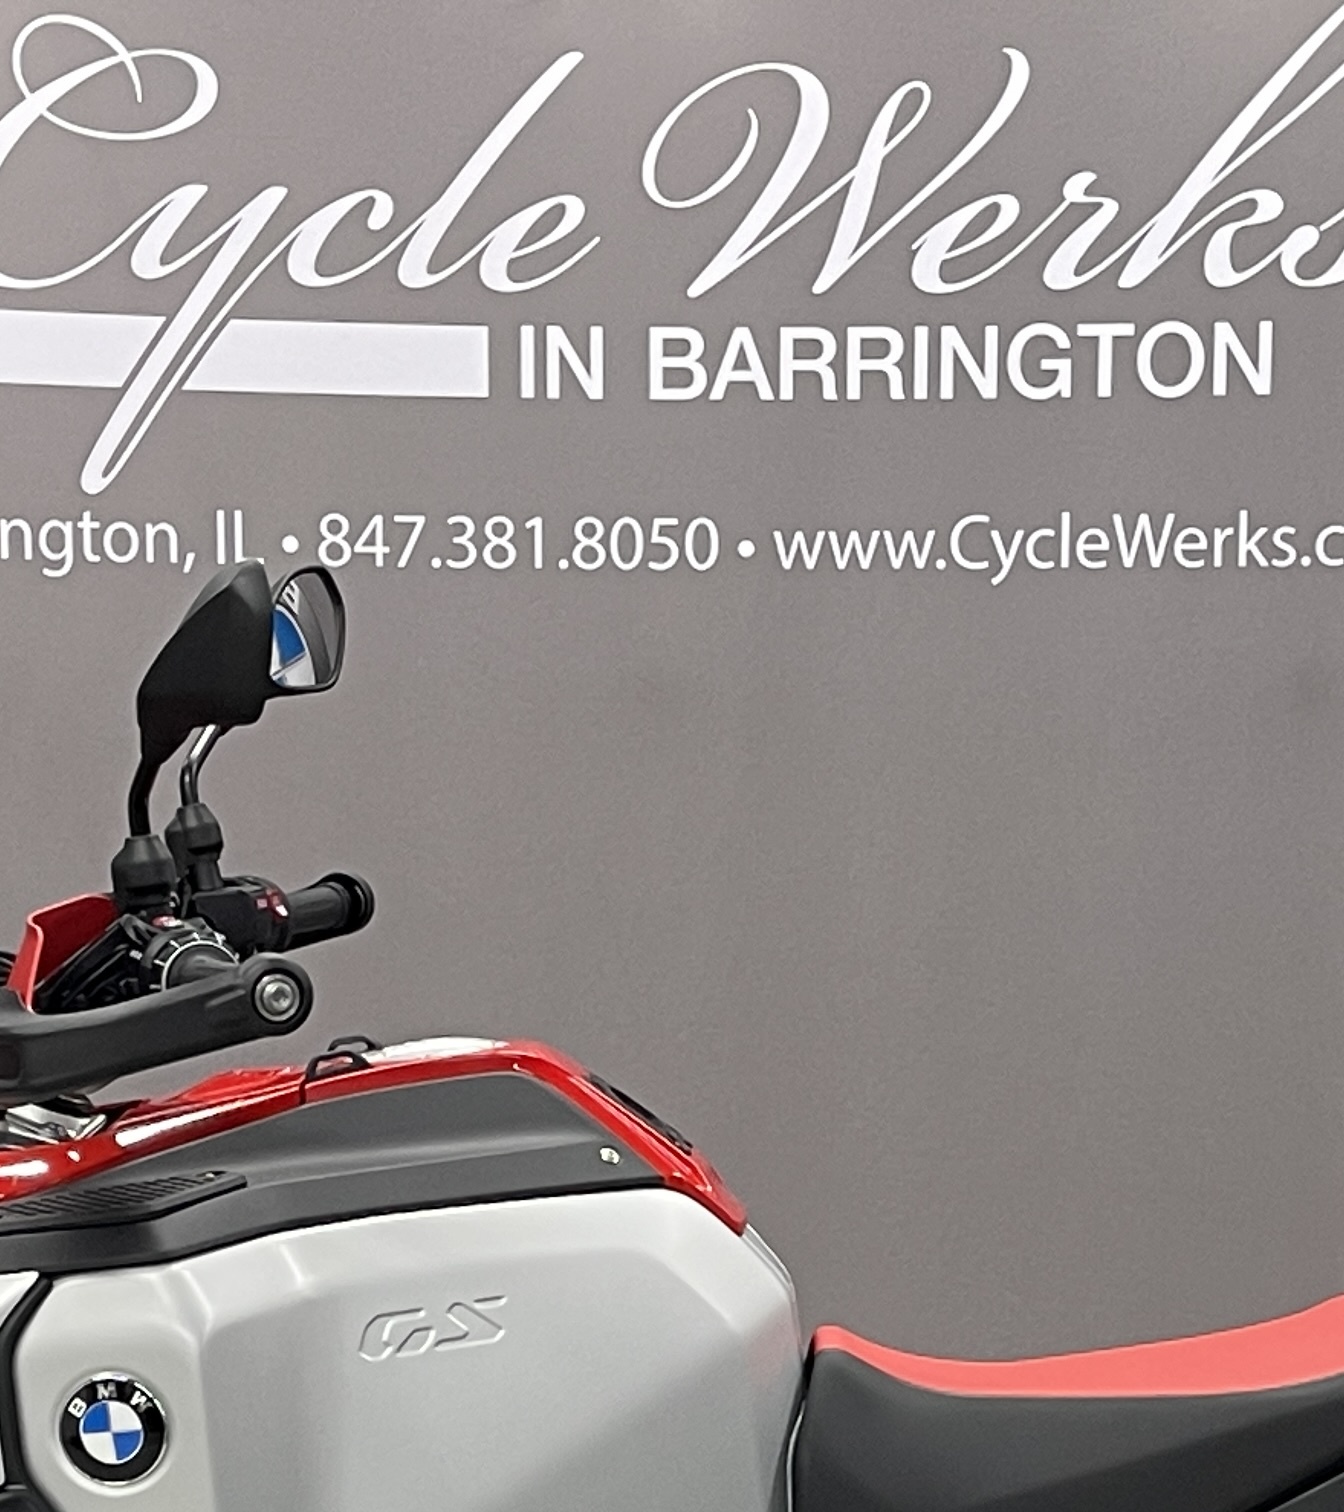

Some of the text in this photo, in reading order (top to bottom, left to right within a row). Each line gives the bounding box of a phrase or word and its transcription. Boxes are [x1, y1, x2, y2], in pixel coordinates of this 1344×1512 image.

[519, 320, 1274, 401] IN BARRINGTON
[216, 509, 265, 565] IL
[317, 512, 720, 571] 847.381.8050
[358, 1295, 508, 1362] GS
[67, 1381, 154, 1418] BMW
